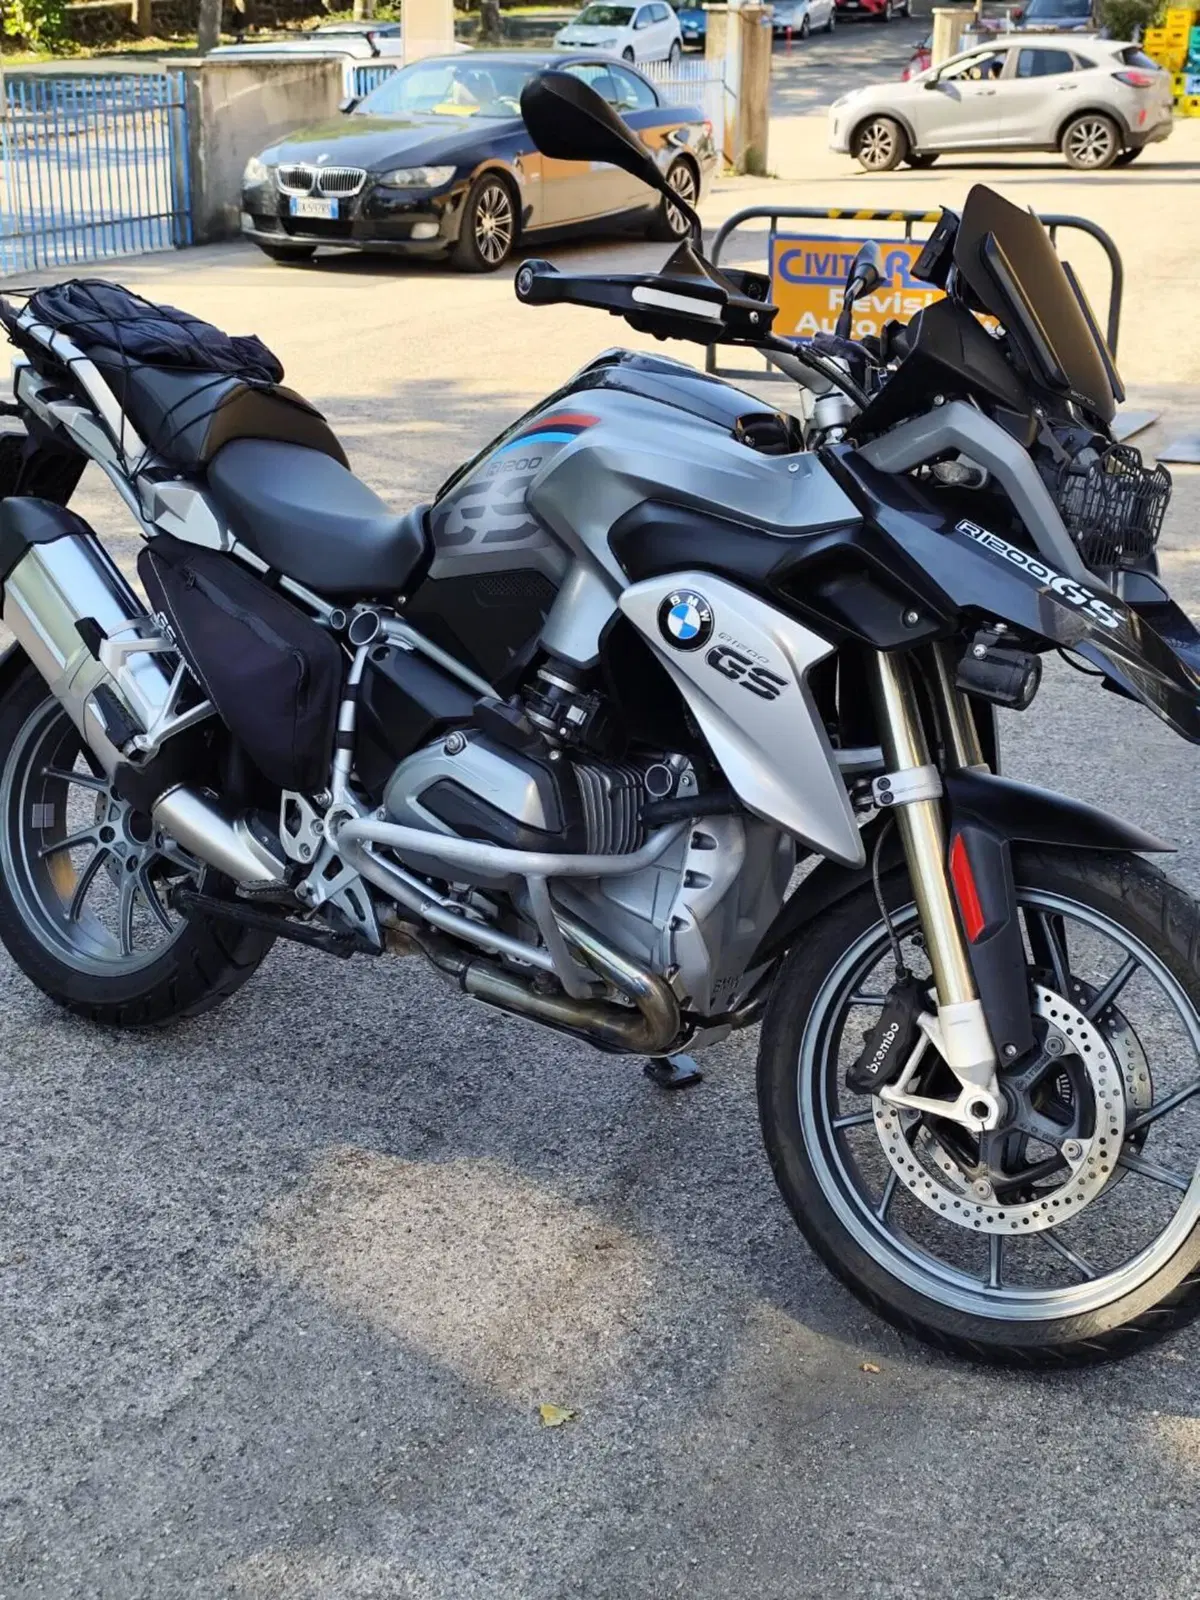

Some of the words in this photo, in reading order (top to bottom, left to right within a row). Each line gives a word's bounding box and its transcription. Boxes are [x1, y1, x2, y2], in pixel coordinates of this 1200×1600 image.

[669, 594, 711, 622] BMW
[706, 645, 789, 701] GS
[865, 1022, 900, 1074] brembo
